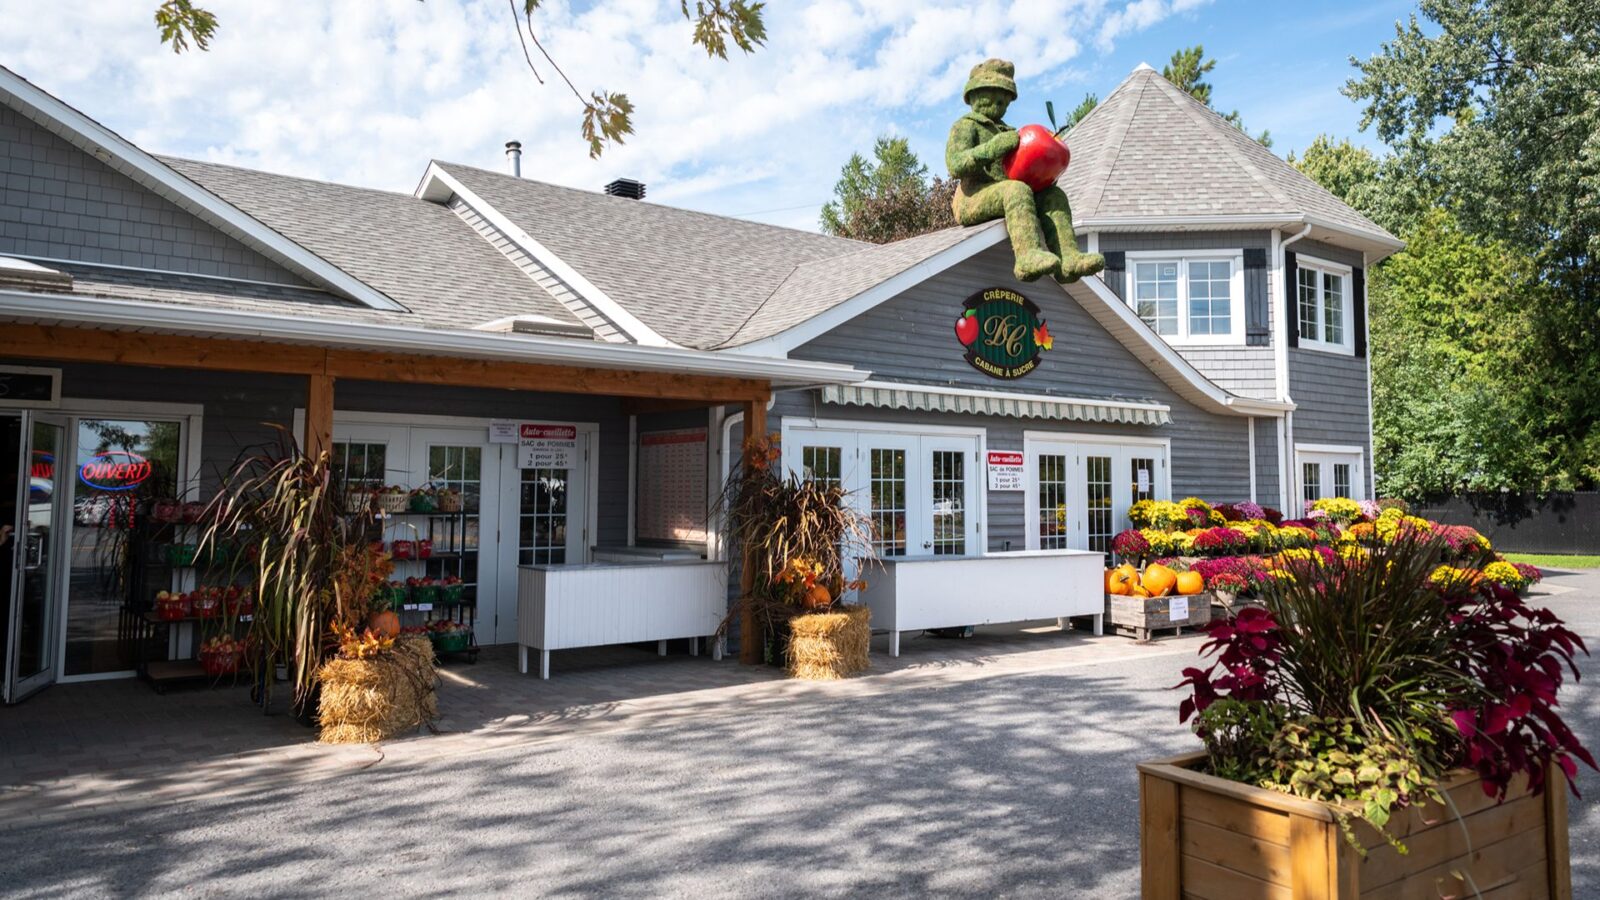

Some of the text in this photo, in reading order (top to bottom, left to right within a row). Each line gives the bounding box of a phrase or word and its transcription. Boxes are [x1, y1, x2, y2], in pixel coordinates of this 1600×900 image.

[983, 290, 1025, 305] CRÊPERIE
[975, 357, 1034, 377] CABANE À SUCRE
[83, 463, 145, 479] OUVERT
